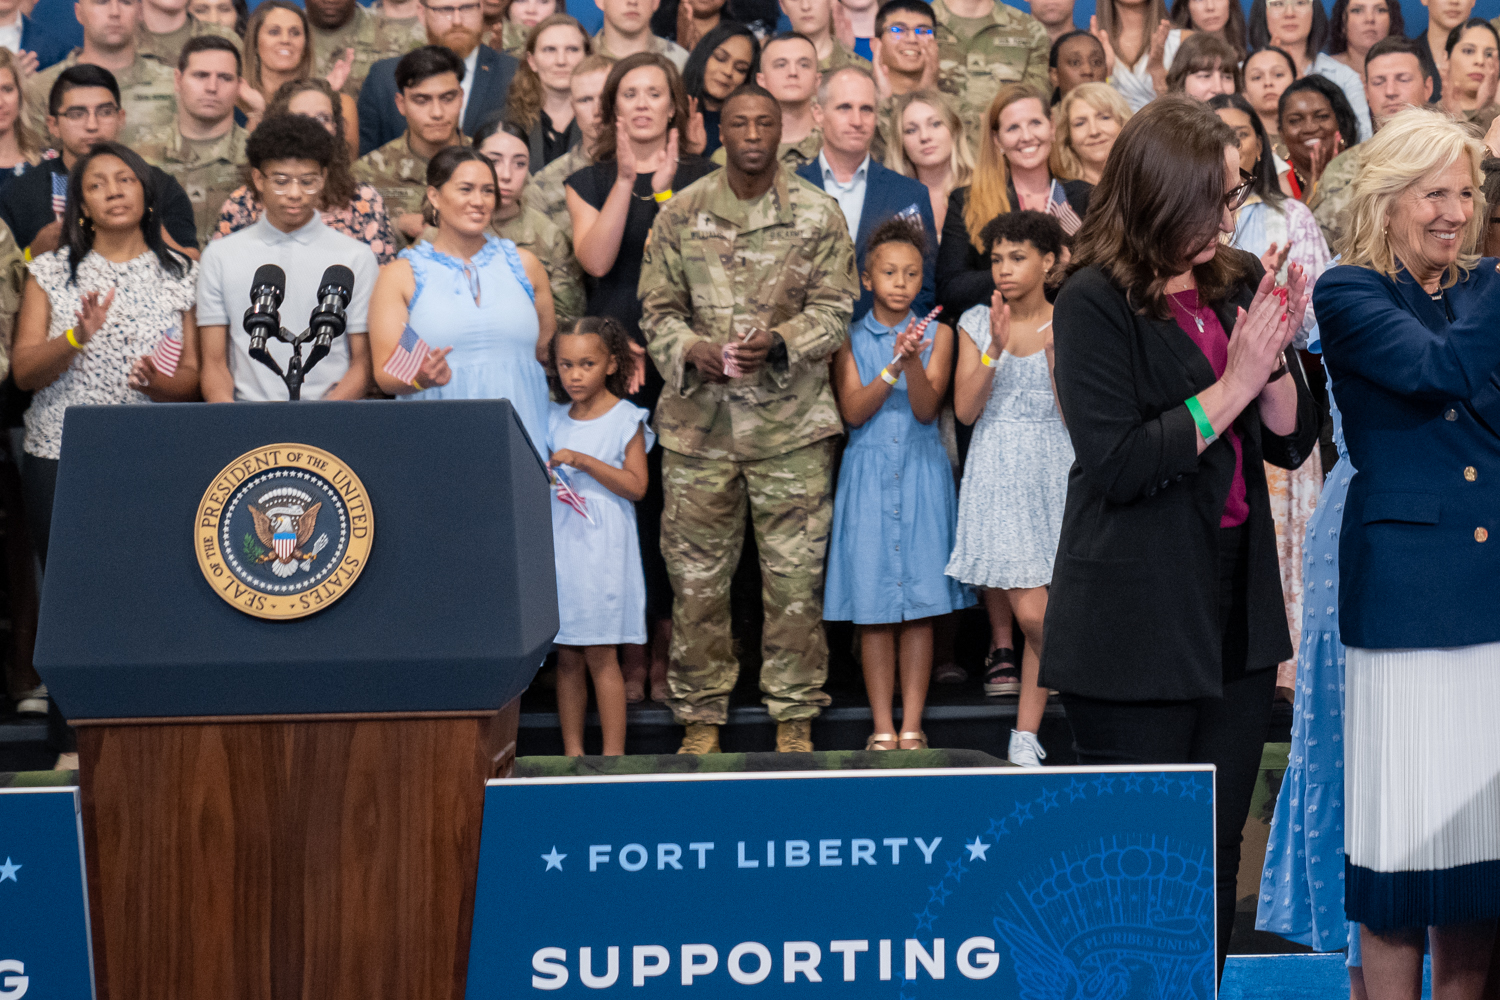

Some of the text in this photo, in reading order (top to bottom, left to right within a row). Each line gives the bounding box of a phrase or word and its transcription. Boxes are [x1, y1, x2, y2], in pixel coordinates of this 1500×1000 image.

[201, 450, 368, 610] SEAL OF THE PRESIDENT OF THE UNITED STATES
[590, 838, 943, 873] FORT LIBERTY
[532, 936, 1001, 991] SUPPORTING
